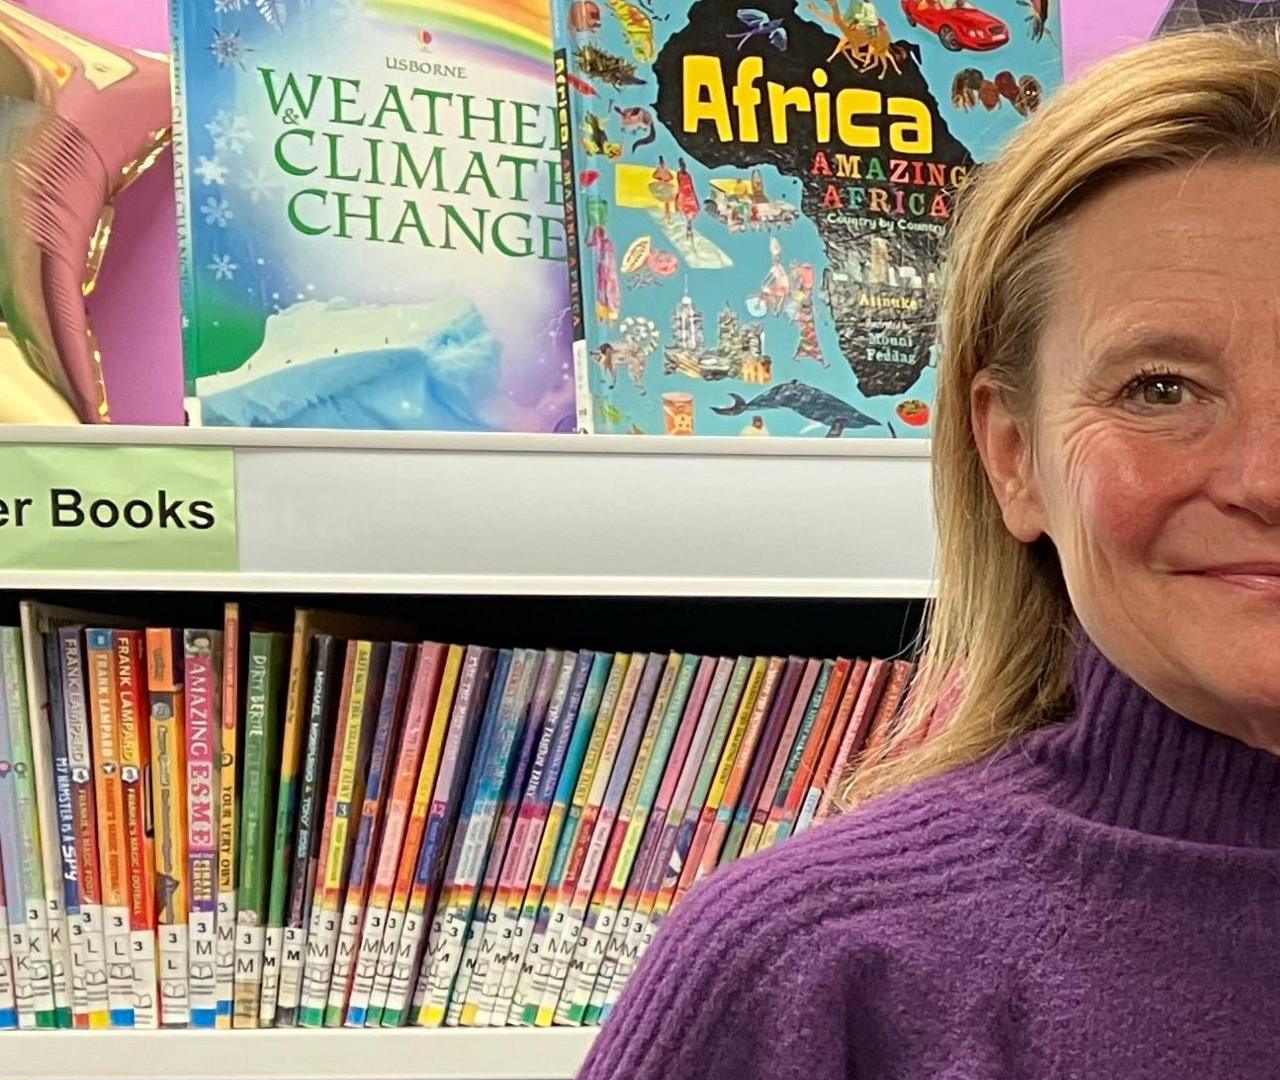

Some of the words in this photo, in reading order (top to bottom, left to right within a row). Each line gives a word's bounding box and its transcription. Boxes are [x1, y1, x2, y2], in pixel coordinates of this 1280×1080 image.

[386, 57, 466, 79] USBORNE
[282, 108, 299, 125] &
[682, 54, 933, 154] Africa
[811, 150, 970, 187] AMAZING
[821, 185, 950, 218] AFRICA
[826, 214, 876, 232] Country
[879, 217, 895, 233] by
[288, 188, 568, 261] CHANGE
[50, 488, 215, 529] Books
[118, 637, 132, 685] FRANK
[121, 691, 139, 760] LAMPARD
[190, 663, 211, 756] AMAZING
[190, 762, 214, 845] ESME
